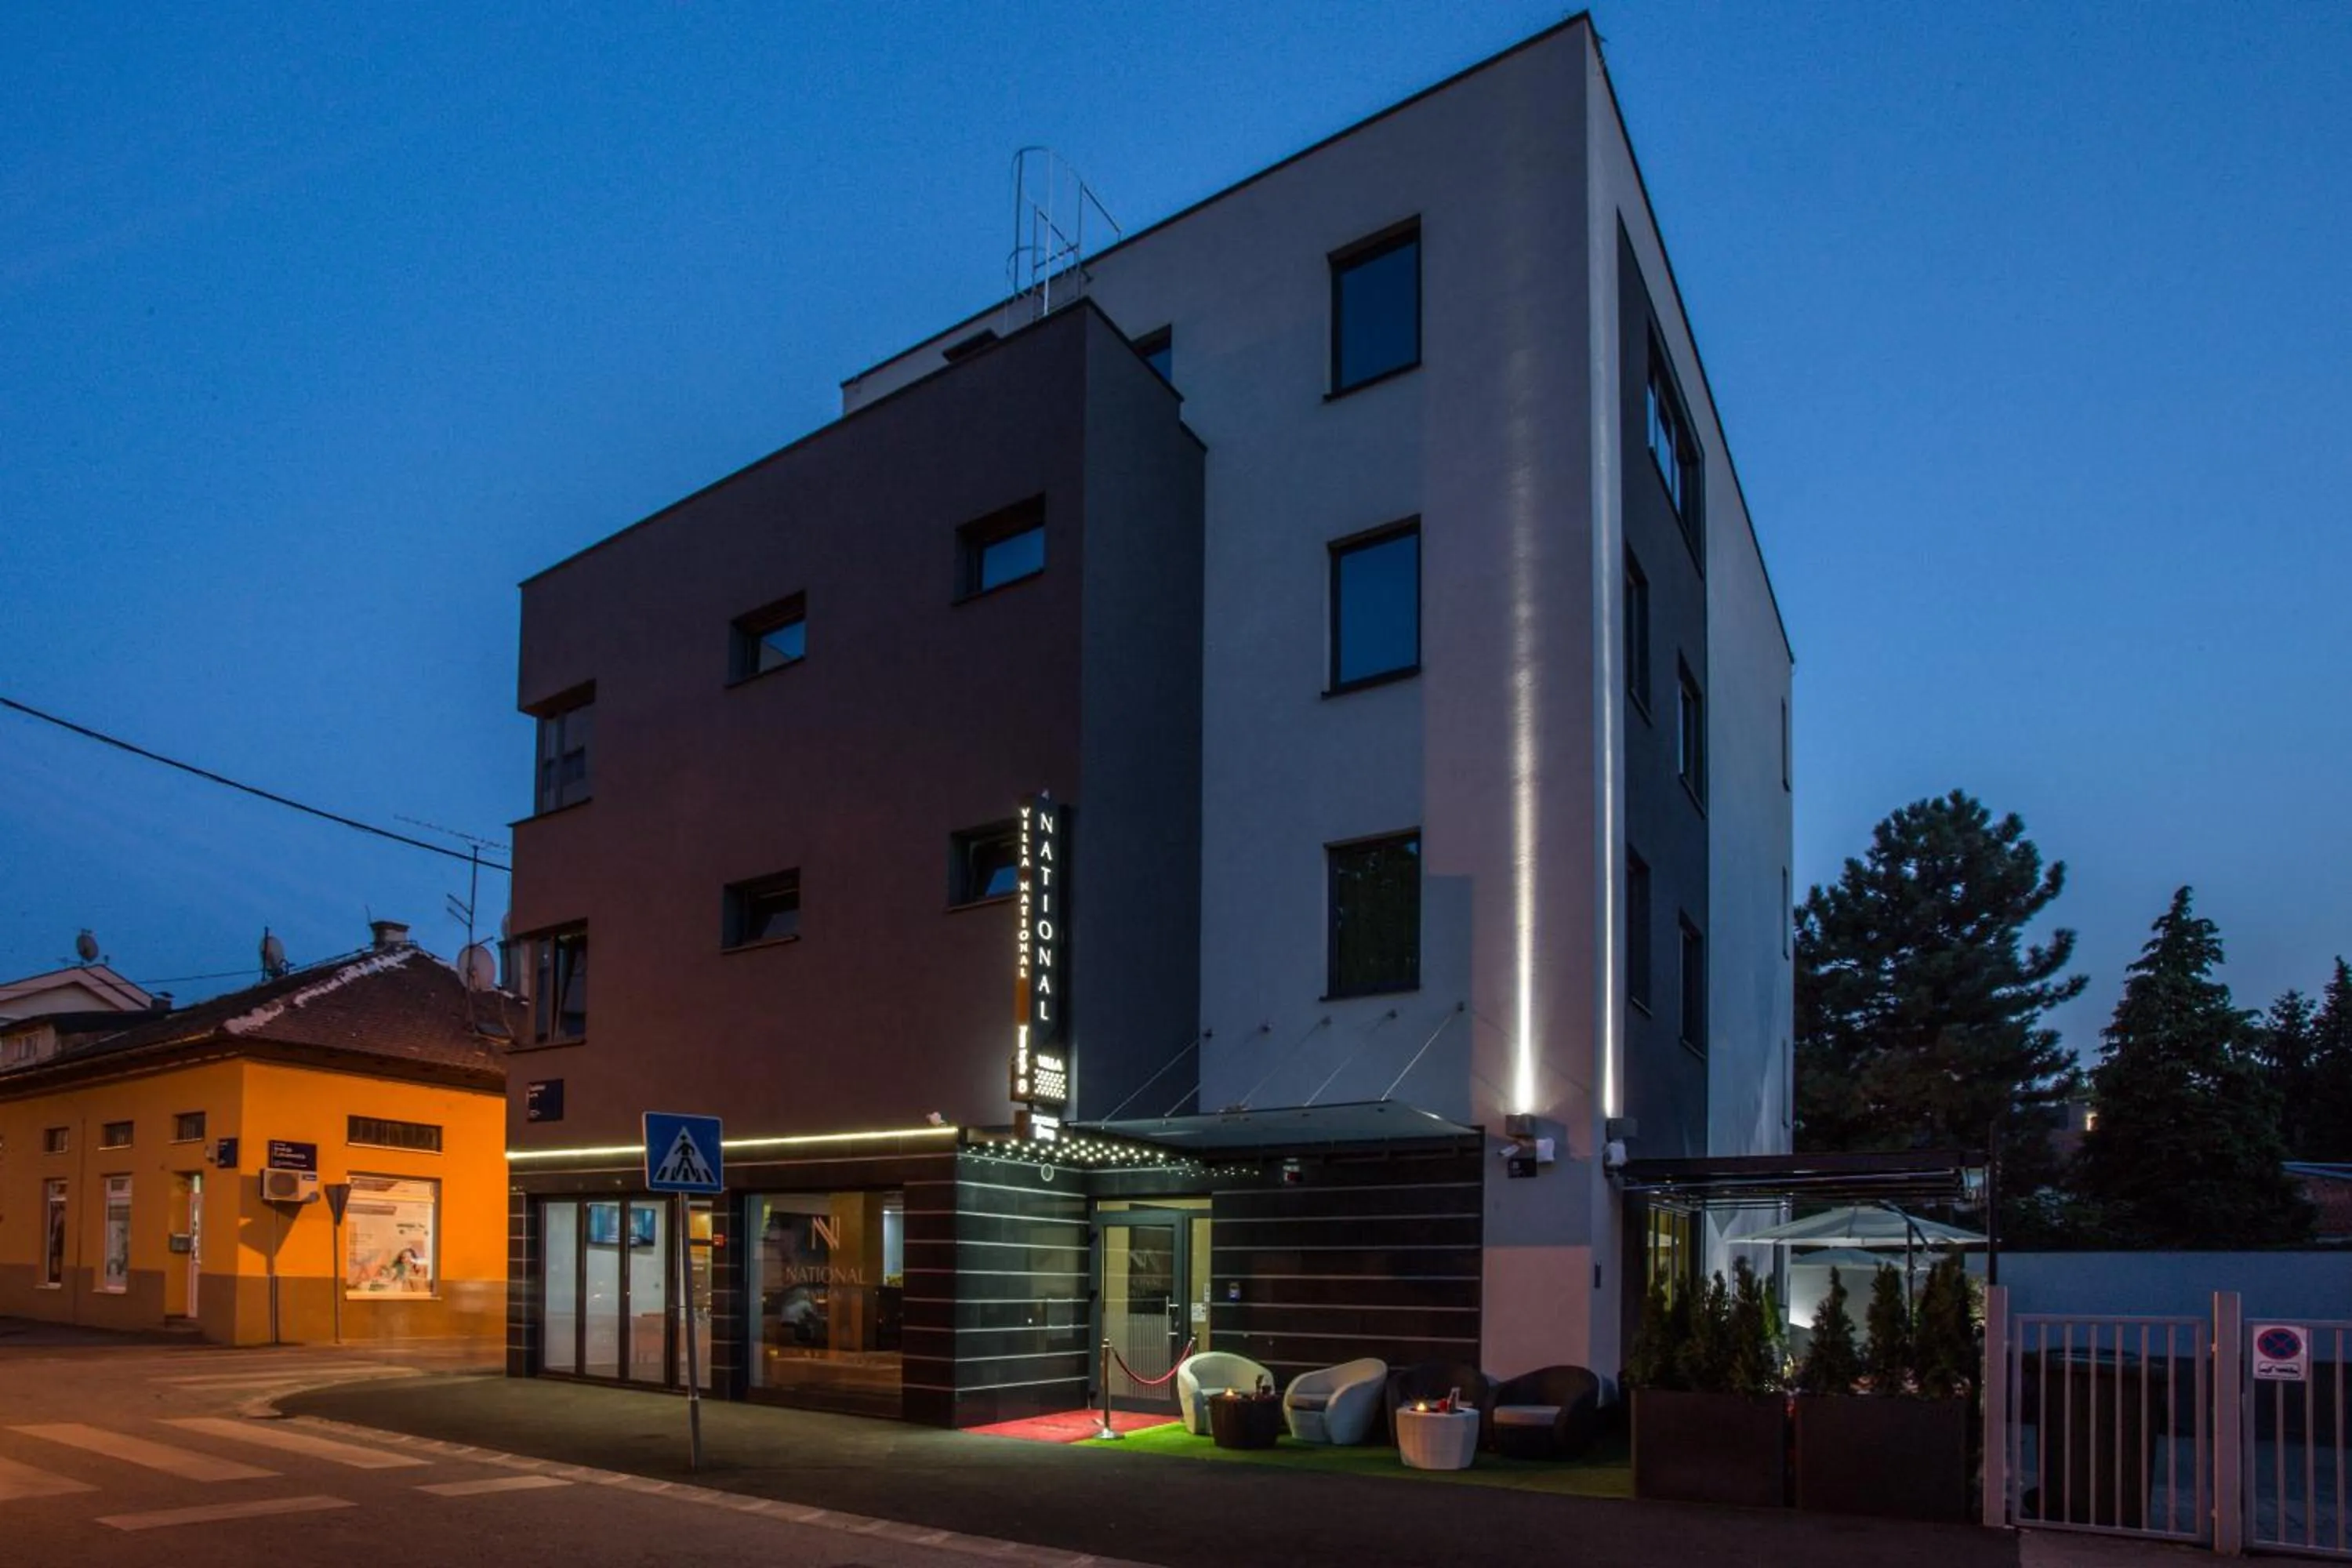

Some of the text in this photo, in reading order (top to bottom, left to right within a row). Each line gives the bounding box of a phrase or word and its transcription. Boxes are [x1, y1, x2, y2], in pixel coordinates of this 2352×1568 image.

[1019, 807, 1030, 978] VILLA NATIONAL
[1037, 811, 1053, 1020] NATIONAL
[786, 1265, 867, 1284] NATIONAL
